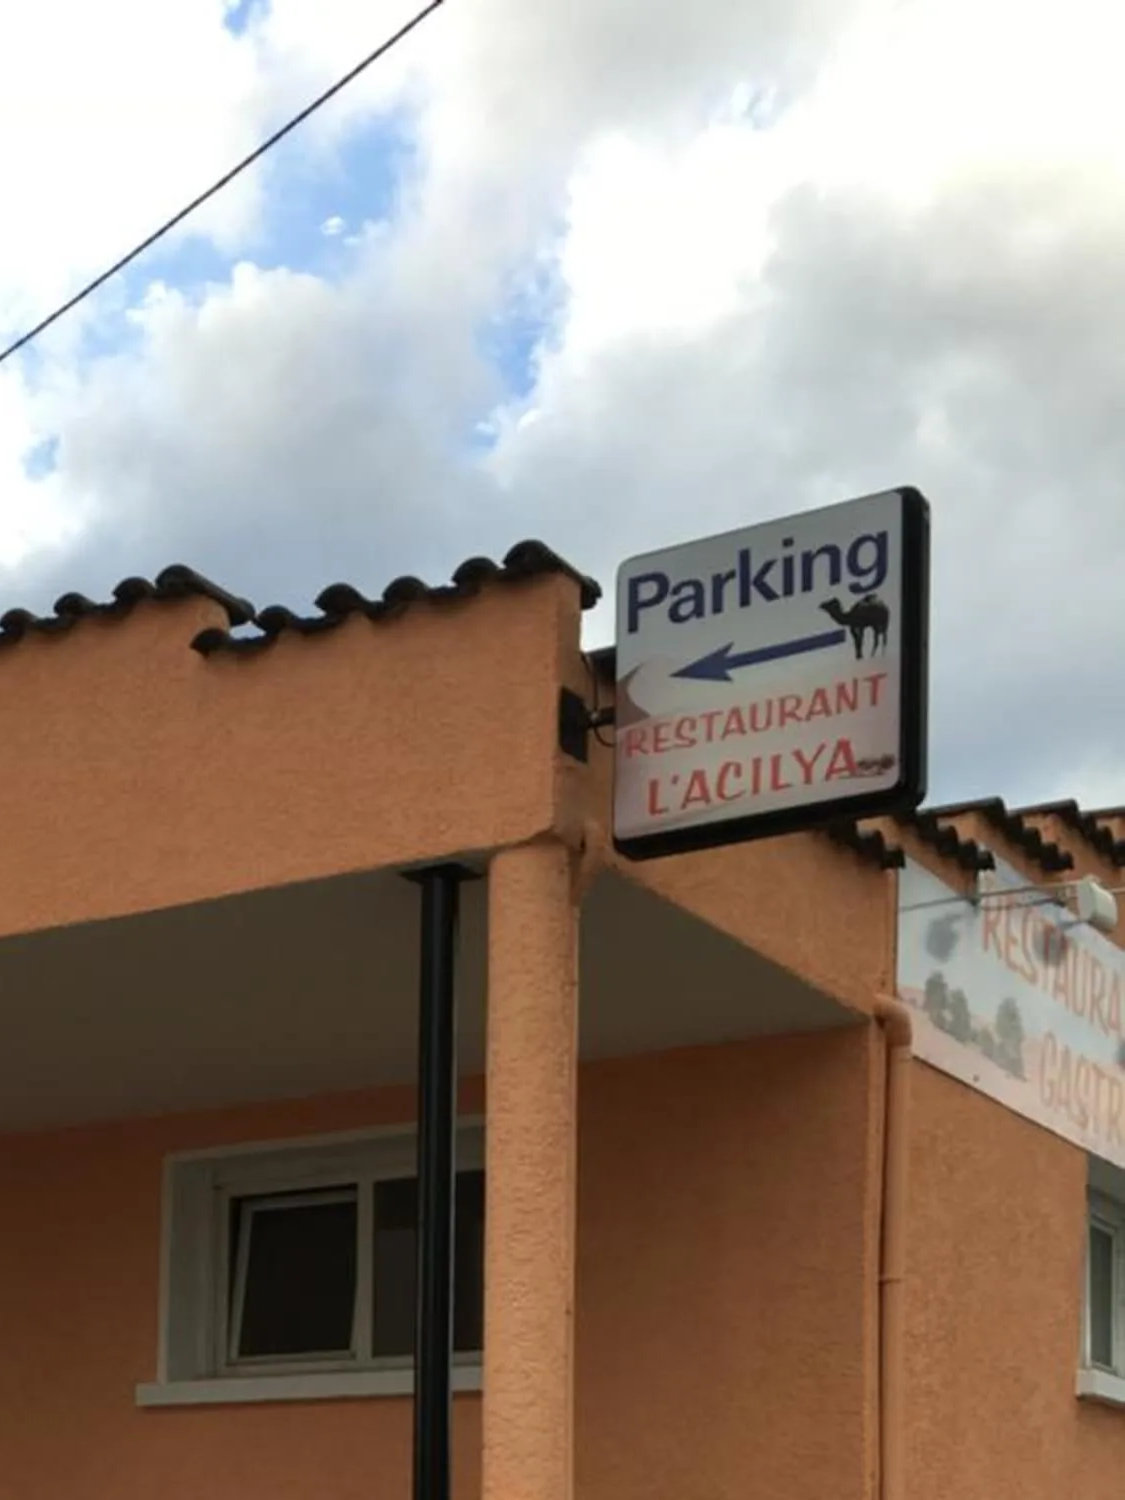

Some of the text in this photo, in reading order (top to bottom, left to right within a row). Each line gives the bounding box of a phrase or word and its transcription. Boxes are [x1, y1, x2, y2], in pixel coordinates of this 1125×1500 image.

[626, 529, 889, 634] Parking
[625, 672, 888, 758] RESTAURANT
[646, 737, 859, 817] L'ACILYA
